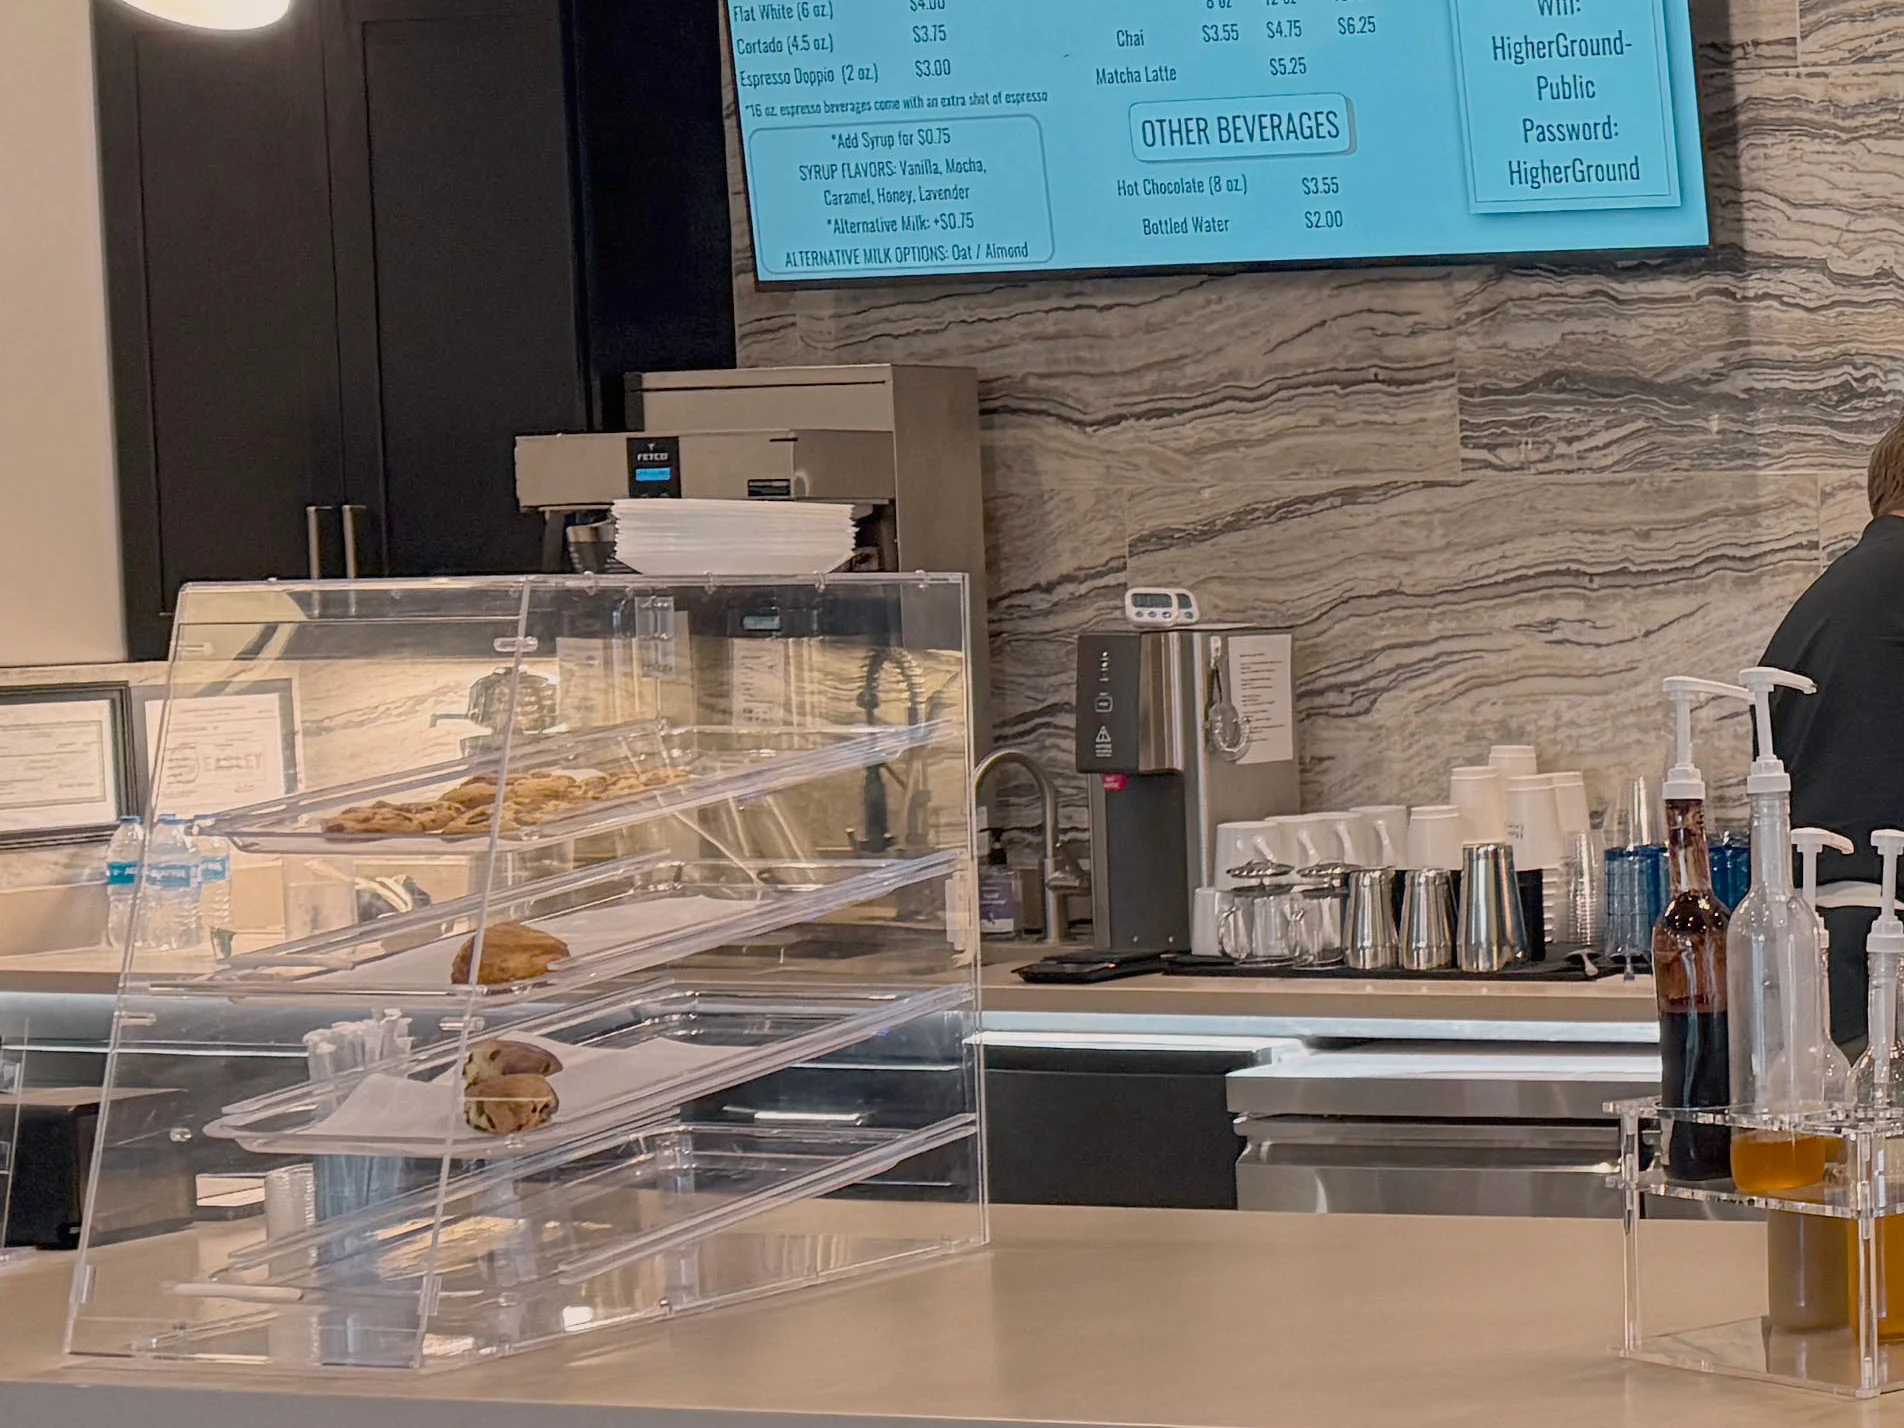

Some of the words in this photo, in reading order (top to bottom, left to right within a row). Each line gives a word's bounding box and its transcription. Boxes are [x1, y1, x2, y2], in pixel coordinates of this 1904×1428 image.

[1116, 29, 1145, 47] Chai
[1201, 23, 1239, 43] $3.55
[1266, 19, 1302, 39] $4.75
[1337, 15, 1376, 35] $6.25
[1491, 29, 1632, 65] HigherGround-
[739, 70, 791, 90] Espresso
[793, 66, 835, 87] Doppio
[841, 64, 855, 85] (2
[857, 62, 879, 84] oz.)
[914, 58, 951, 78] $3.00
[1095, 66, 1142, 85] Matcha
[1144, 65, 1177, 83] Latte
[1269, 56, 1307, 76] $5.25
[1536, 73, 1596, 101] Public
[1141, 117, 1210, 148] OTHER
[1216, 110, 1340, 144] BEVERAGES
[1522, 114, 1619, 144] Password:
[1117, 179, 1140, 196] Hot
[1142, 177, 1205, 196] Chocolate
[1208, 175, 1222, 196] (8
[1226, 173, 1247, 195] oz.)
[1301, 176, 1339, 196] $3.55
[1508, 155, 1640, 190] HigherGround
[1142, 216, 1189, 236] Bottled
[1191, 215, 1229, 233] Water
[1304, 209, 1343, 229] $2.00
